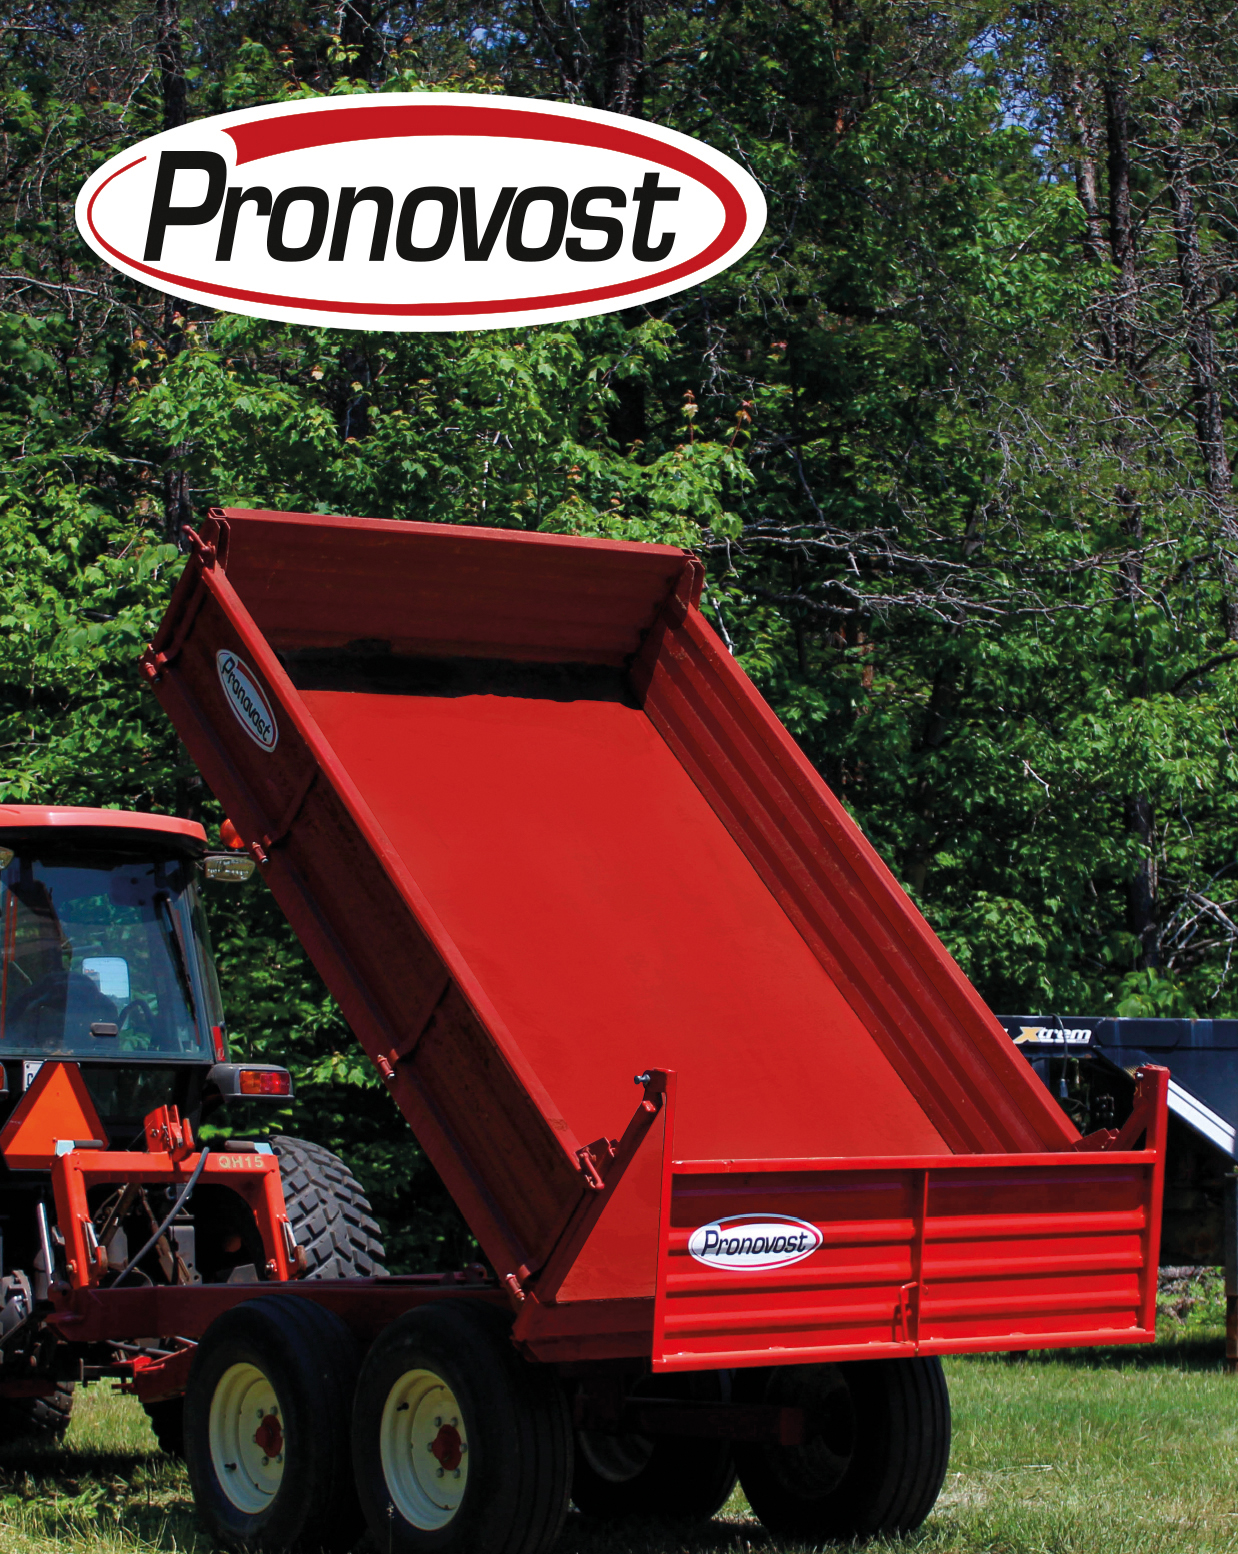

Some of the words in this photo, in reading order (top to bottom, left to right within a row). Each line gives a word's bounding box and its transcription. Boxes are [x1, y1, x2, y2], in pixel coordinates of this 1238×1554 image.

[221, 656, 271, 742] Pronovost
[1012, 1026, 1092, 1044] Xtrem
[218, 1155, 264, 1169] QH15
[700, 1229, 808, 1257] Pronovost
